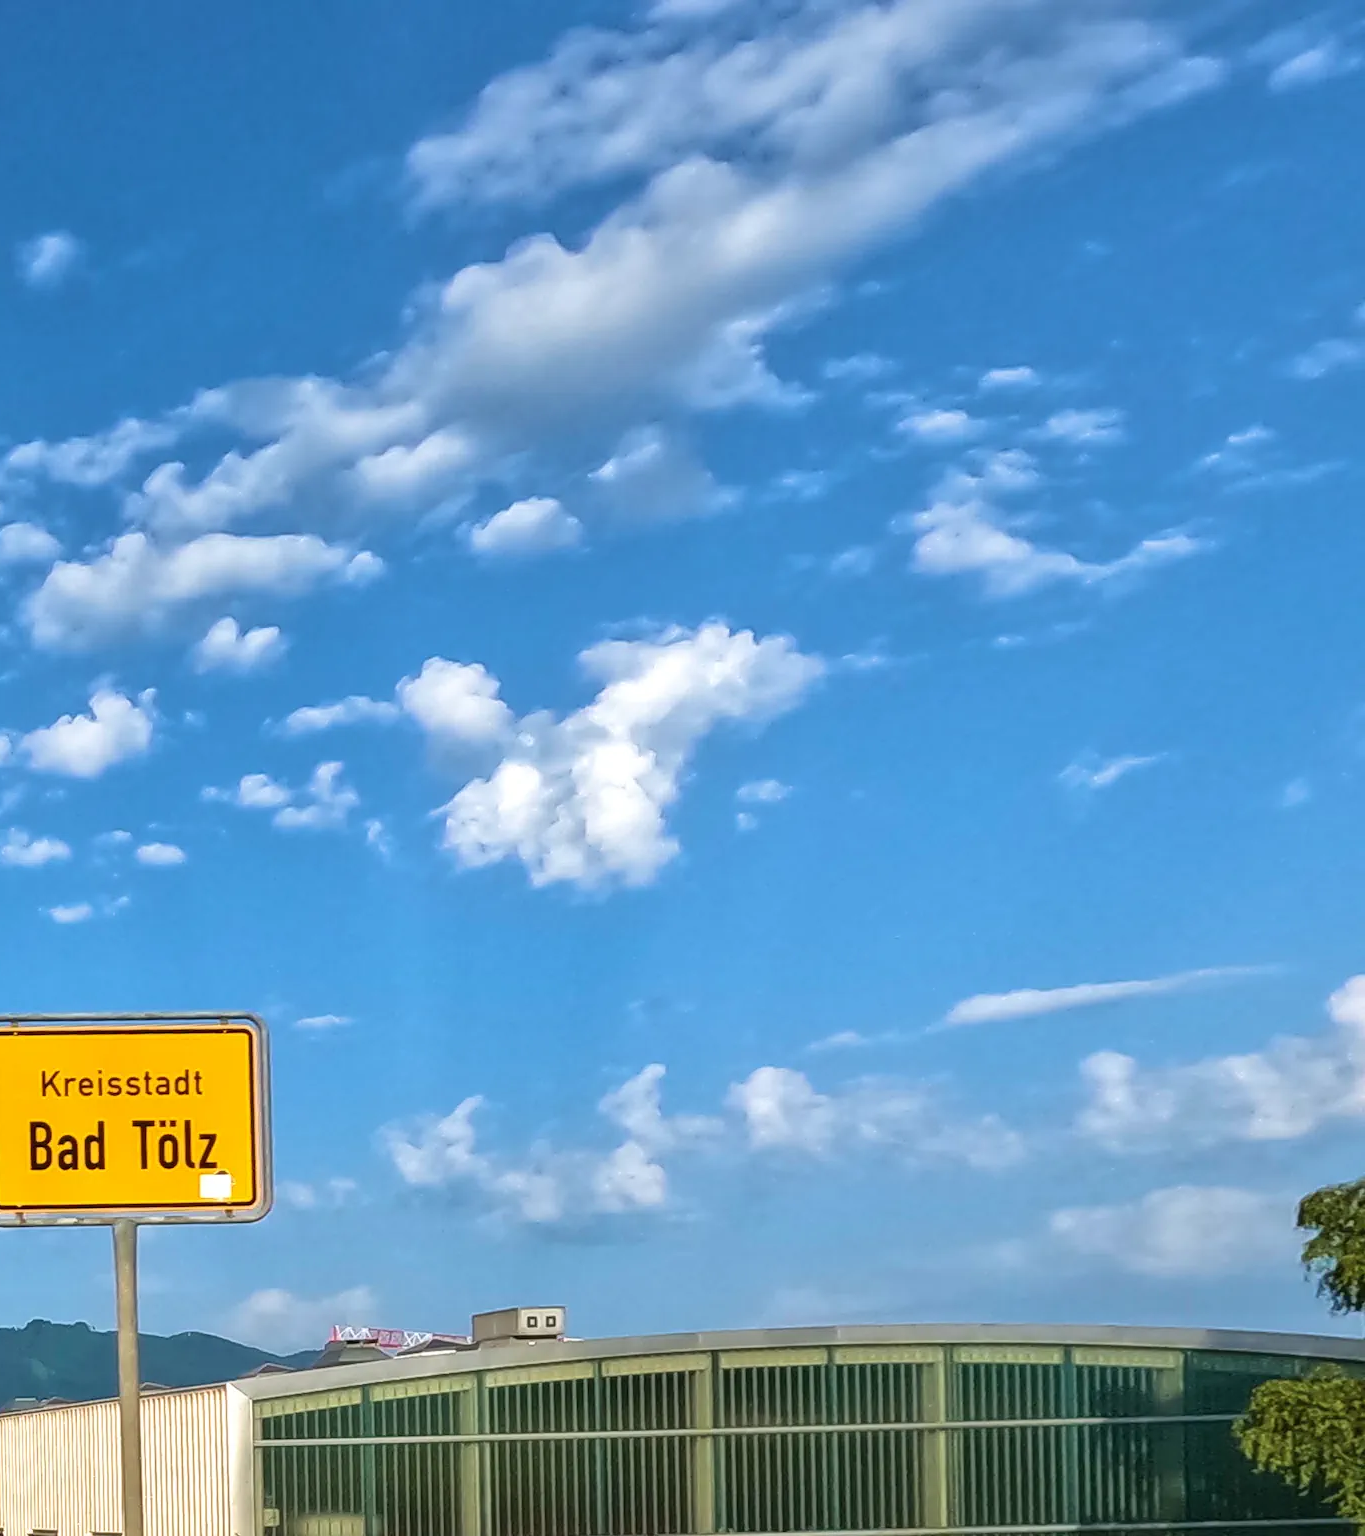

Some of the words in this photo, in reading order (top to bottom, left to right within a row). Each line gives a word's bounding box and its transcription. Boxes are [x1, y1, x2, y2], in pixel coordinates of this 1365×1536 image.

[41, 1069, 203, 1097] Kreisstadt
[29, 1120, 106, 1171] Bad
[132, 1119, 218, 1170] Tölz
